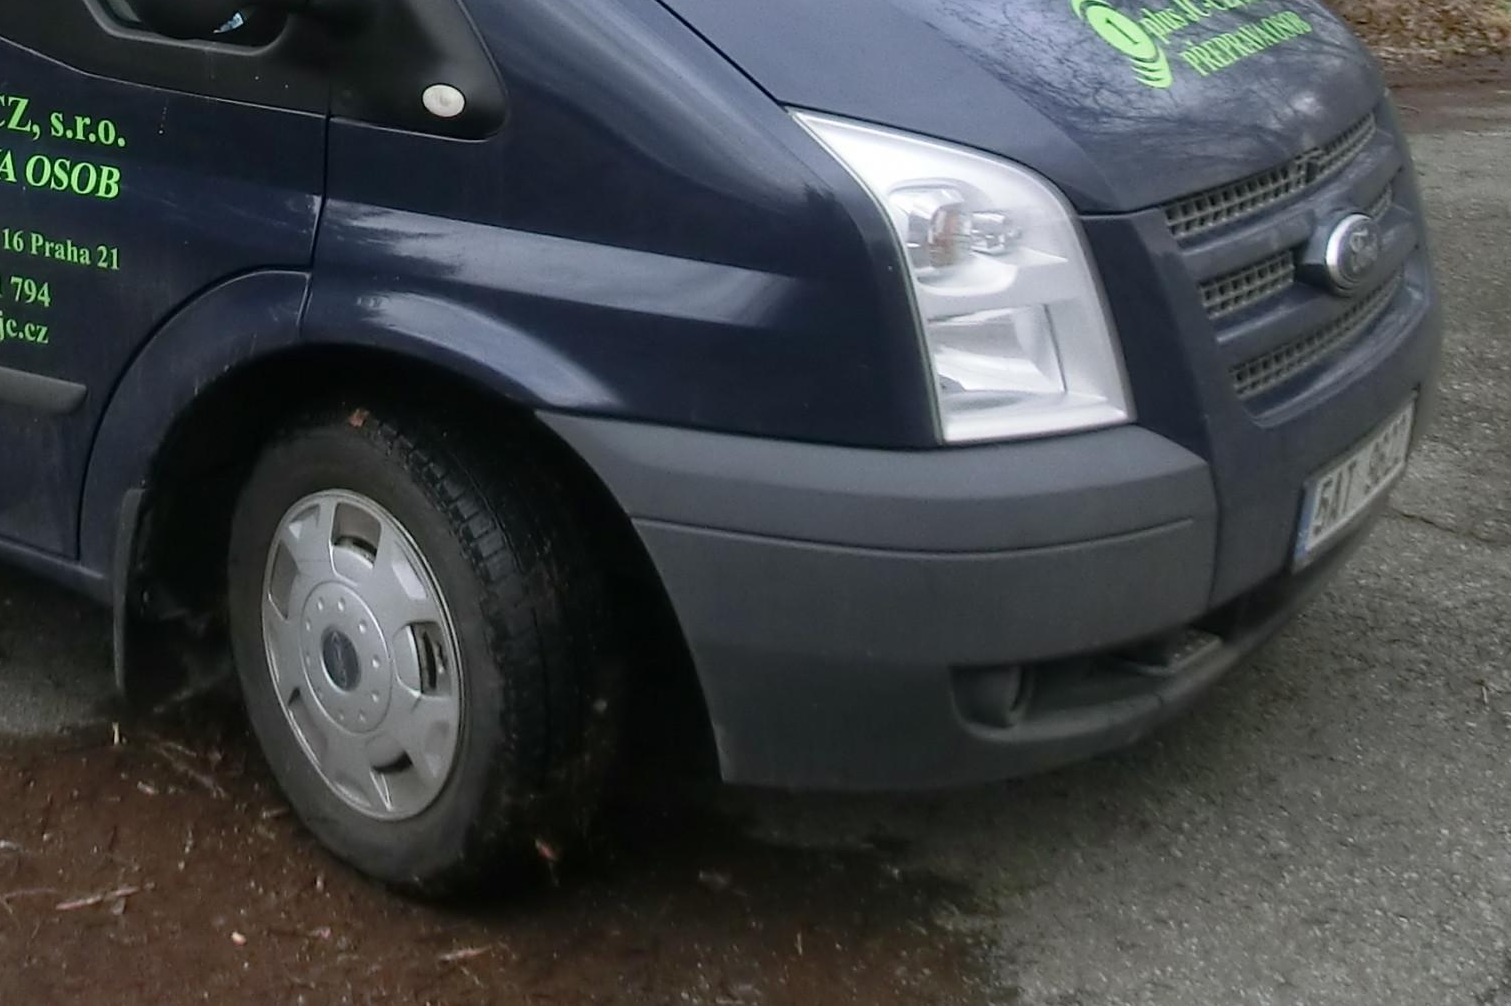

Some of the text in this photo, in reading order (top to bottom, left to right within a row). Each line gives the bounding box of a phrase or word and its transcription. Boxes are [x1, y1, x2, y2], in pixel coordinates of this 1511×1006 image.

[1139, 8, 1188, 44] plus
[1178, 22, 1280, 76] PŘEPRAVA
[50, 111, 126, 147] s.r.o.
[25, 154, 122, 199] OSOB
[3, 228, 24, 253] 16
[30, 232, 91, 266] Praha
[96, 245, 121, 270] 21
[10, 278, 51, 307] 794
